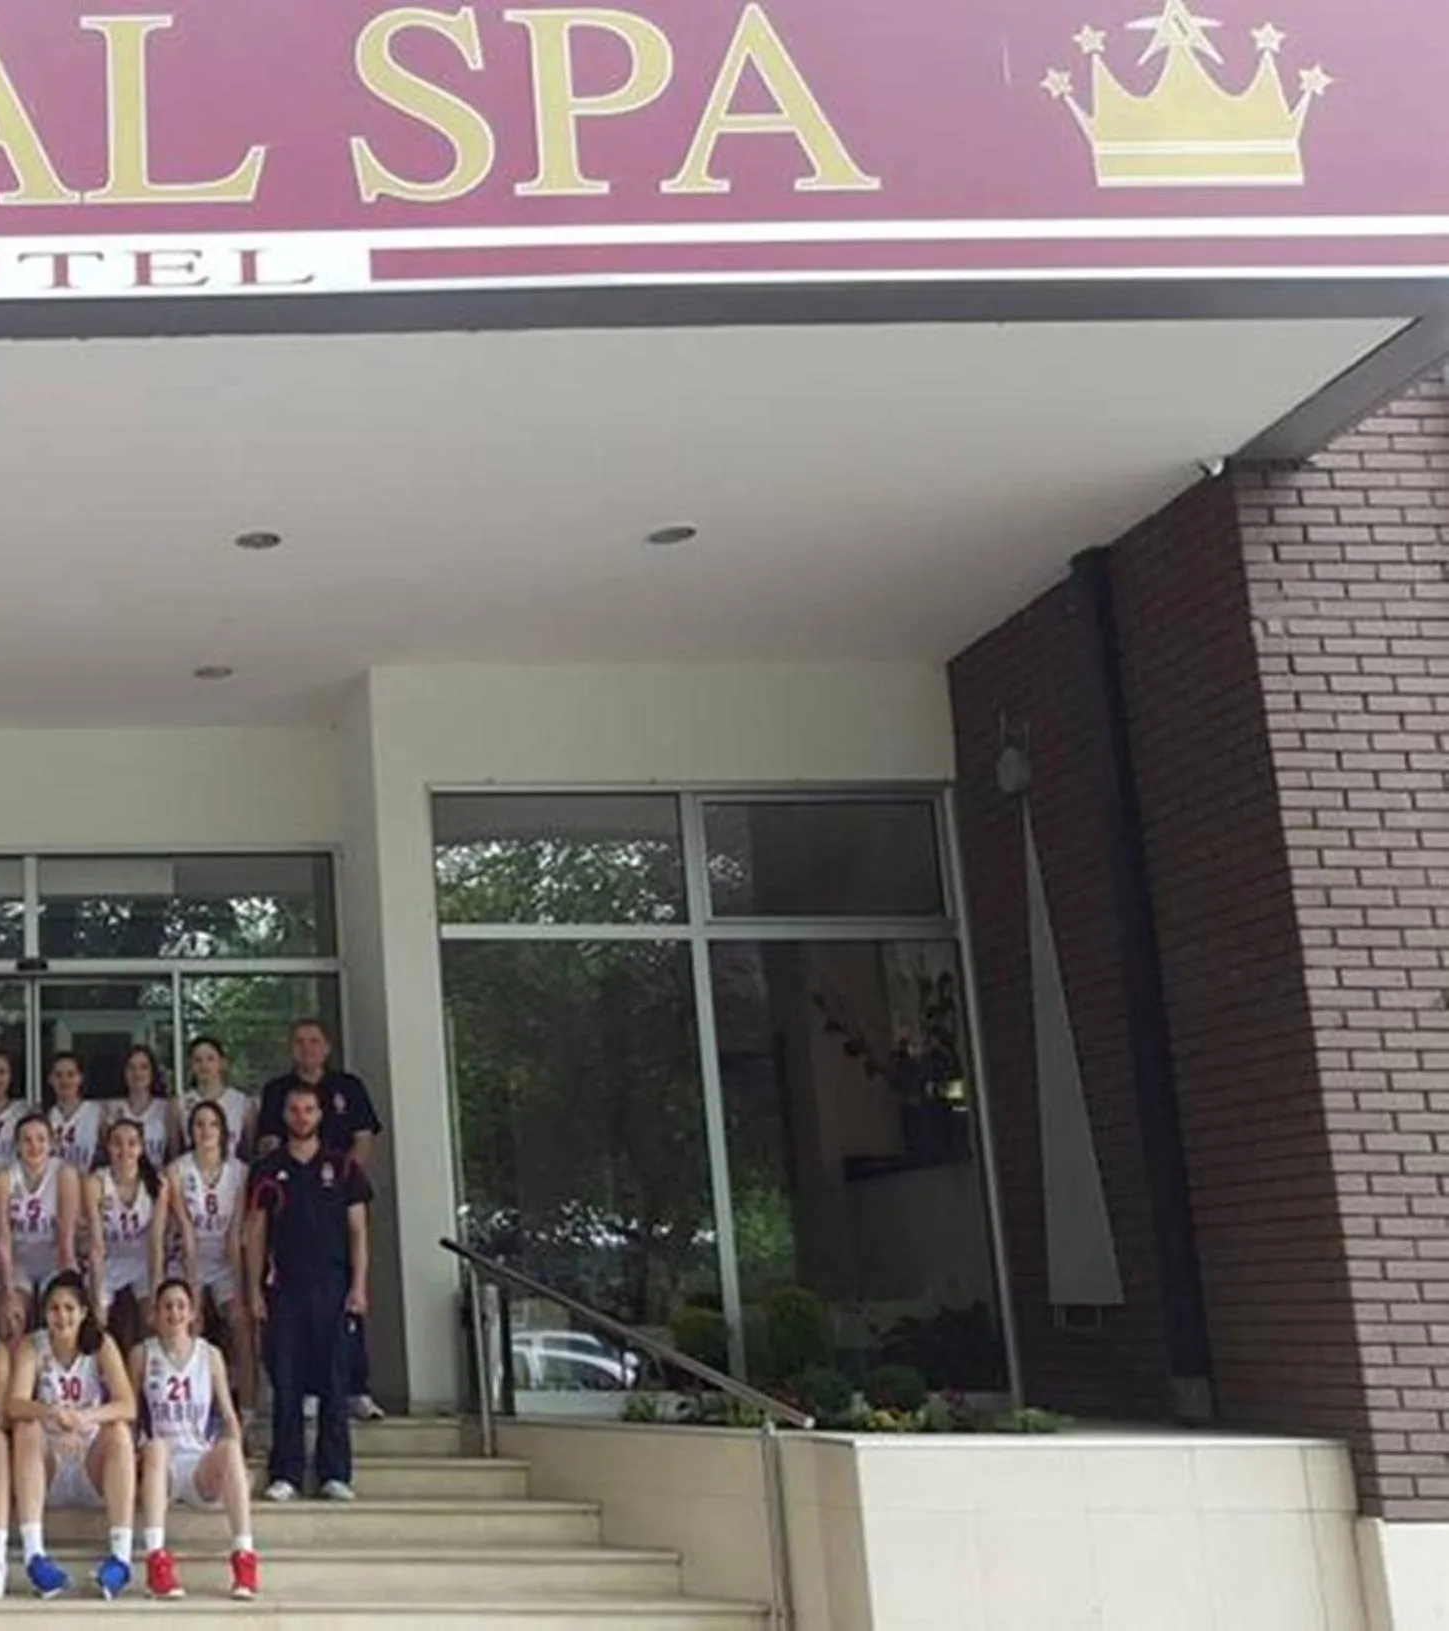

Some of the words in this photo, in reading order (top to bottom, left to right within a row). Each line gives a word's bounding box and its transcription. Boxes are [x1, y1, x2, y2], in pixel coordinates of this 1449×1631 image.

[350, 2, 883, 204] SPA
[27, 1198, 42, 1221] 5
[205, 1192, 218, 1216] 6
[166, 1375, 191, 1401] 21
